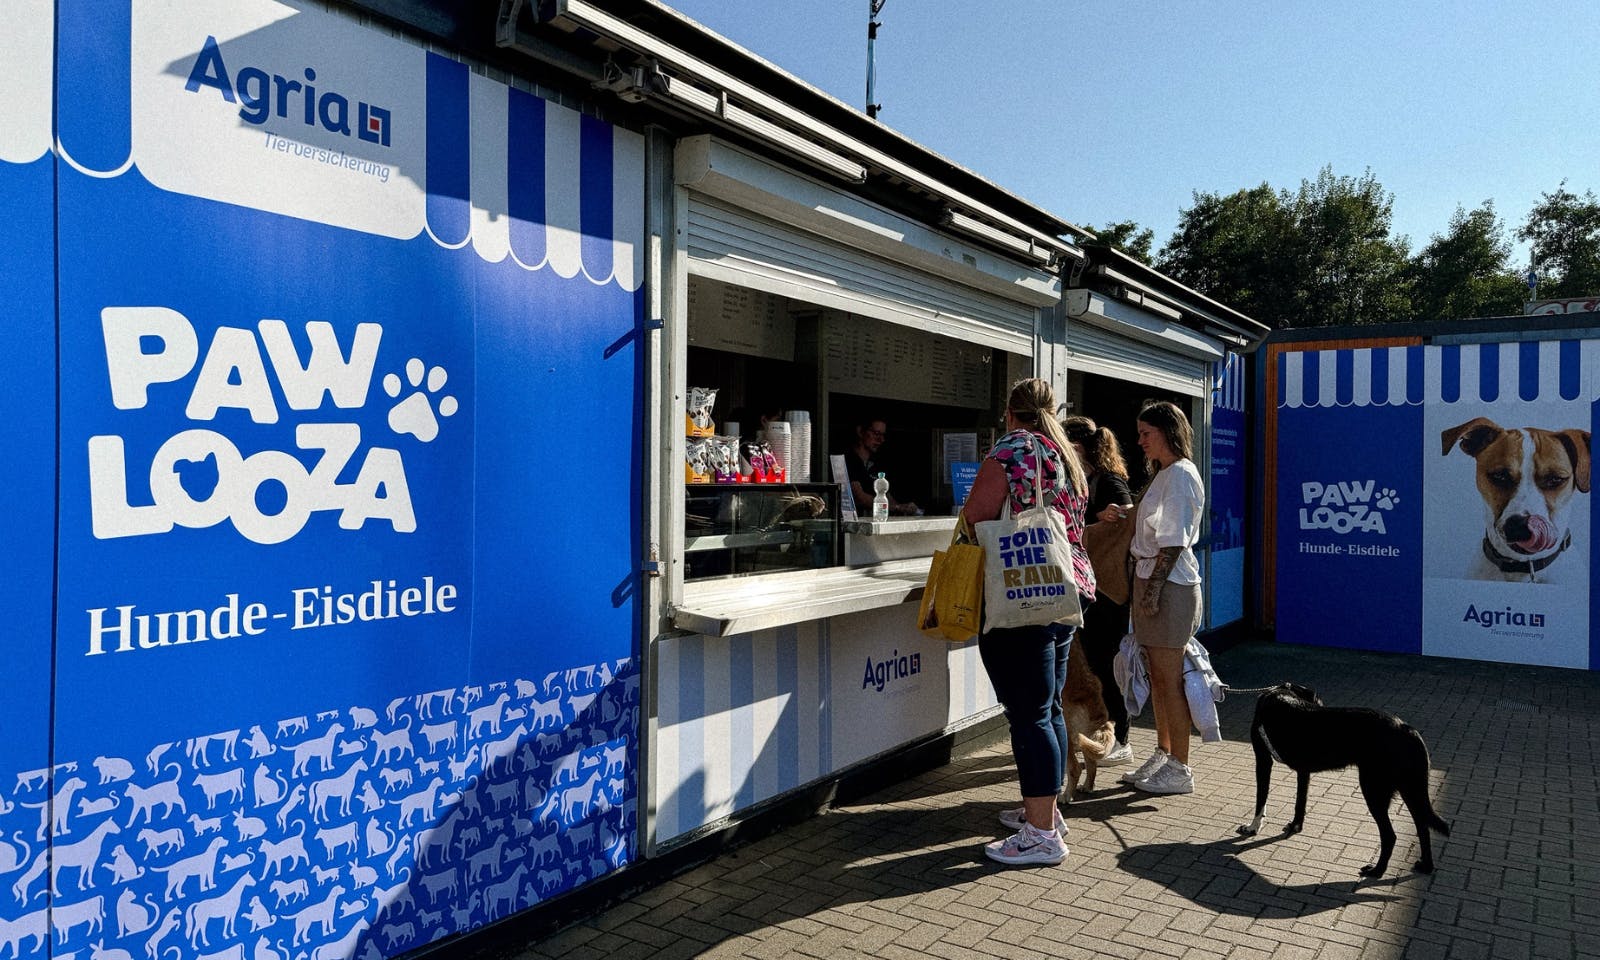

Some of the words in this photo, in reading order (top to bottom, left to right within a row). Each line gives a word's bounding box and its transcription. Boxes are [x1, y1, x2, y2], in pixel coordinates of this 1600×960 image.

[185, 35, 351, 137] Agria
[264, 131, 390, 184] Tierversicherung
[101, 306, 383, 424] PAW
[88, 423, 417, 545] LOOZA
[1302, 480, 1375, 506] PAW
[1299, 505, 1387, 534] LOOZA
[999, 527, 1053, 551] JOIN
[1299, 542, 1400, 557] Hunde-Eisdiele
[1000, 547, 1047, 568] THE
[1003, 565, 1064, 588] RAW
[1006, 585, 1066, 601] OLUTION
[85, 577, 457, 656] Hunde-Eisdiele
[1463, 603, 1527, 628] Agria
[862, 649, 909, 692] Agria
